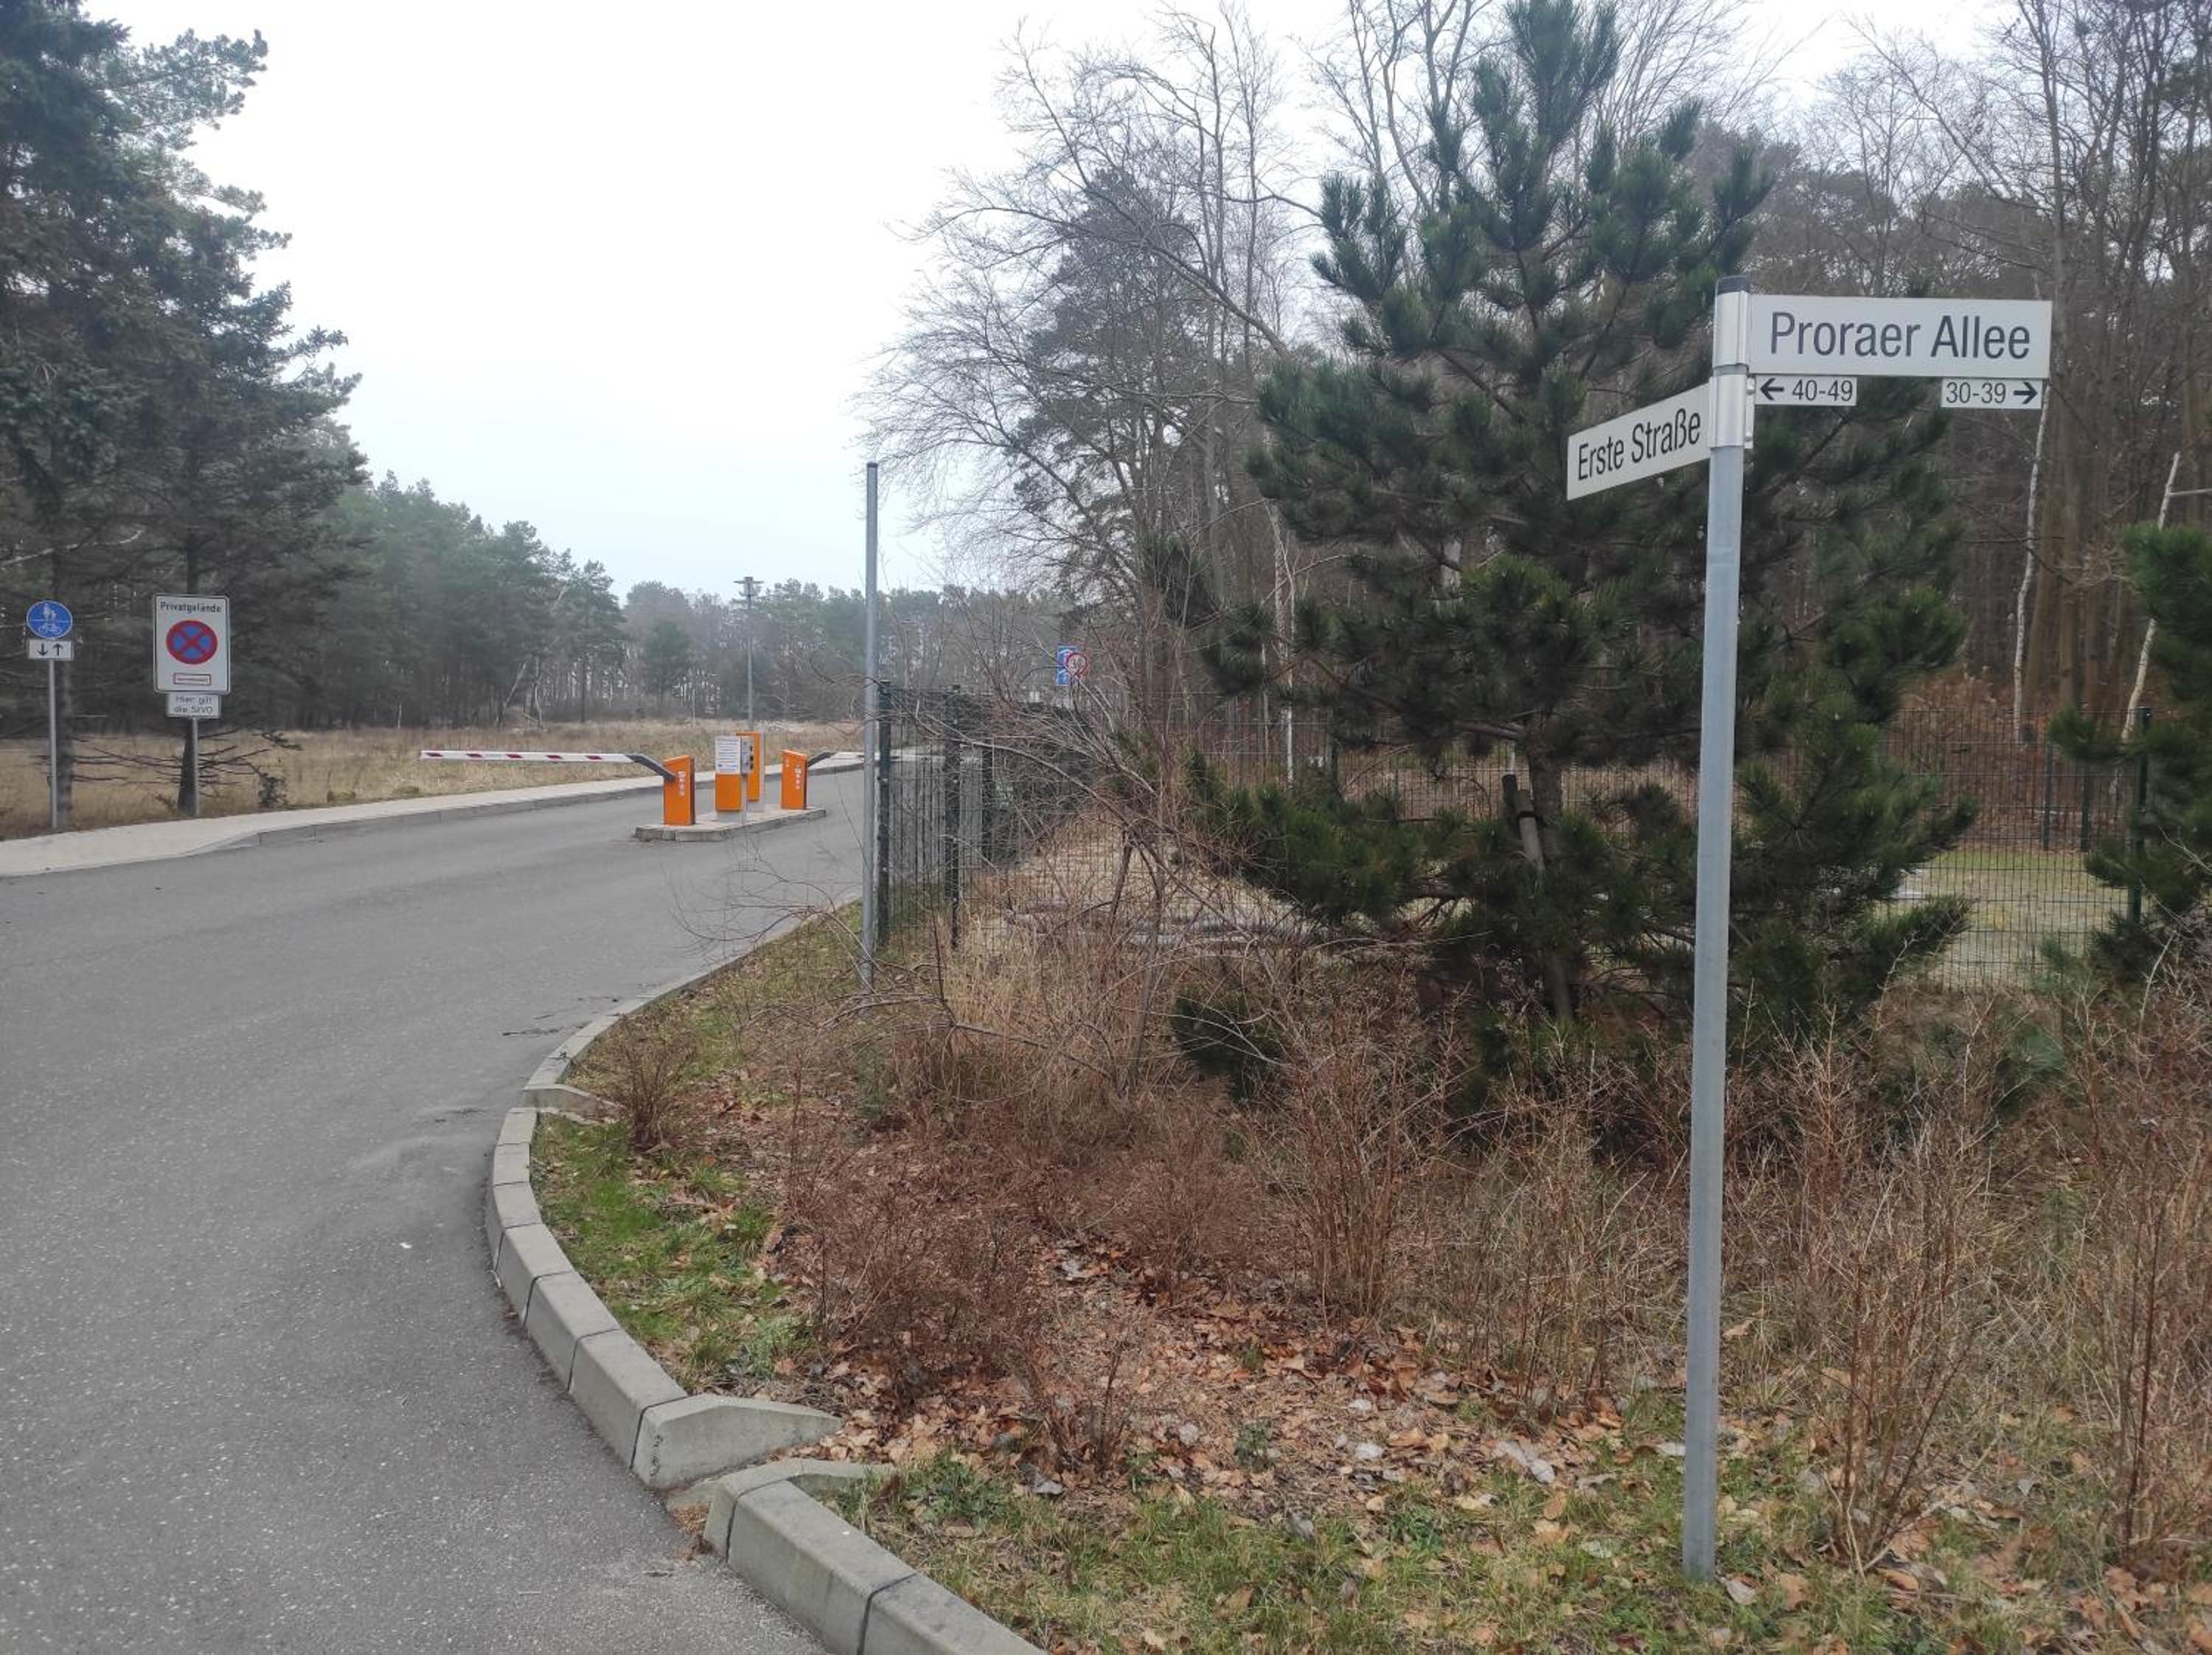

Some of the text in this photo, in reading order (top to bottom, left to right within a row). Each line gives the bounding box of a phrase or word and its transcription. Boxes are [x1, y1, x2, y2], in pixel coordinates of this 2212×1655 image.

[1770, 311, 2031, 360] Proraer Allee
[1792, 379, 1854, 402] 40-49
[1945, 382, 2006, 404] 30-39
[1578, 408, 1701, 481] Erste Straße
[160, 601, 222, 614] Privatgelände
